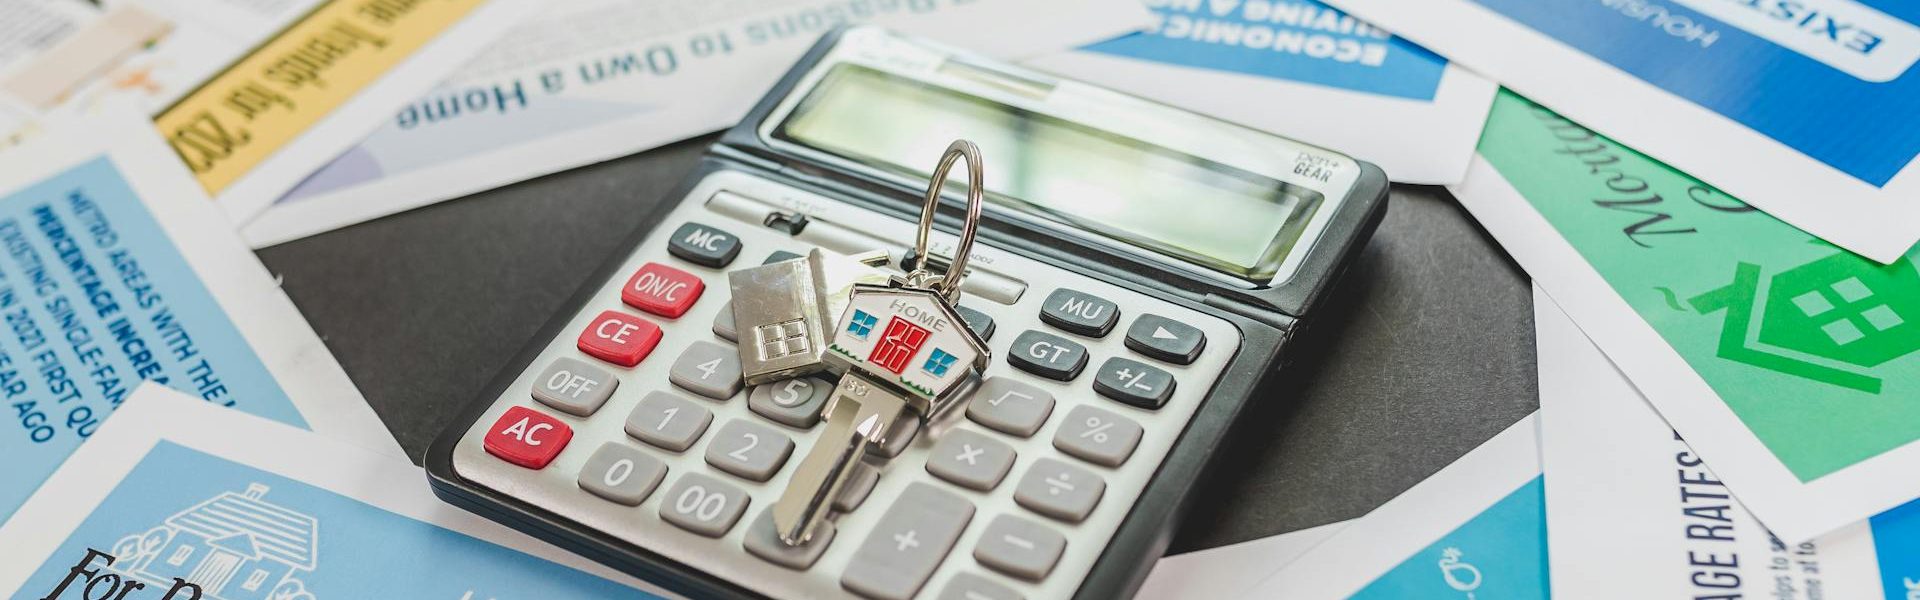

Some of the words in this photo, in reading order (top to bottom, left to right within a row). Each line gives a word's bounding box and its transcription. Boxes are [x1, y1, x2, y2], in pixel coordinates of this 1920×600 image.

[578, 45, 677, 85] Own
[397, 80, 527, 130] Home
[684, 229, 730, 251] MC
[33, 205, 120, 319] PERCENTAGE
[635, 272, 686, 302] ON/C
[889, 299, 948, 332] HOME
[1060, 296, 1103, 319] MU
[109, 250, 162, 310] AREAS
[151, 306, 199, 362] WITH
[188, 359, 229, 402] THE
[596, 319, 639, 345] CE
[1028, 342, 1071, 364] GT
[33, 349, 83, 403] FIRST
[696, 357, 722, 380] 4
[547, 370, 597, 398] OFF
[775, 380, 808, 405] 5
[12, 400, 55, 443] AGO
[502, 417, 553, 446] AC
[655, 406, 679, 431] 1
[1085, 417, 1109, 443] %
[728, 433, 758, 462] 2
[603, 458, 633, 486] 0
[675, 490, 725, 521] 00
[39, 548, 146, 600] For
